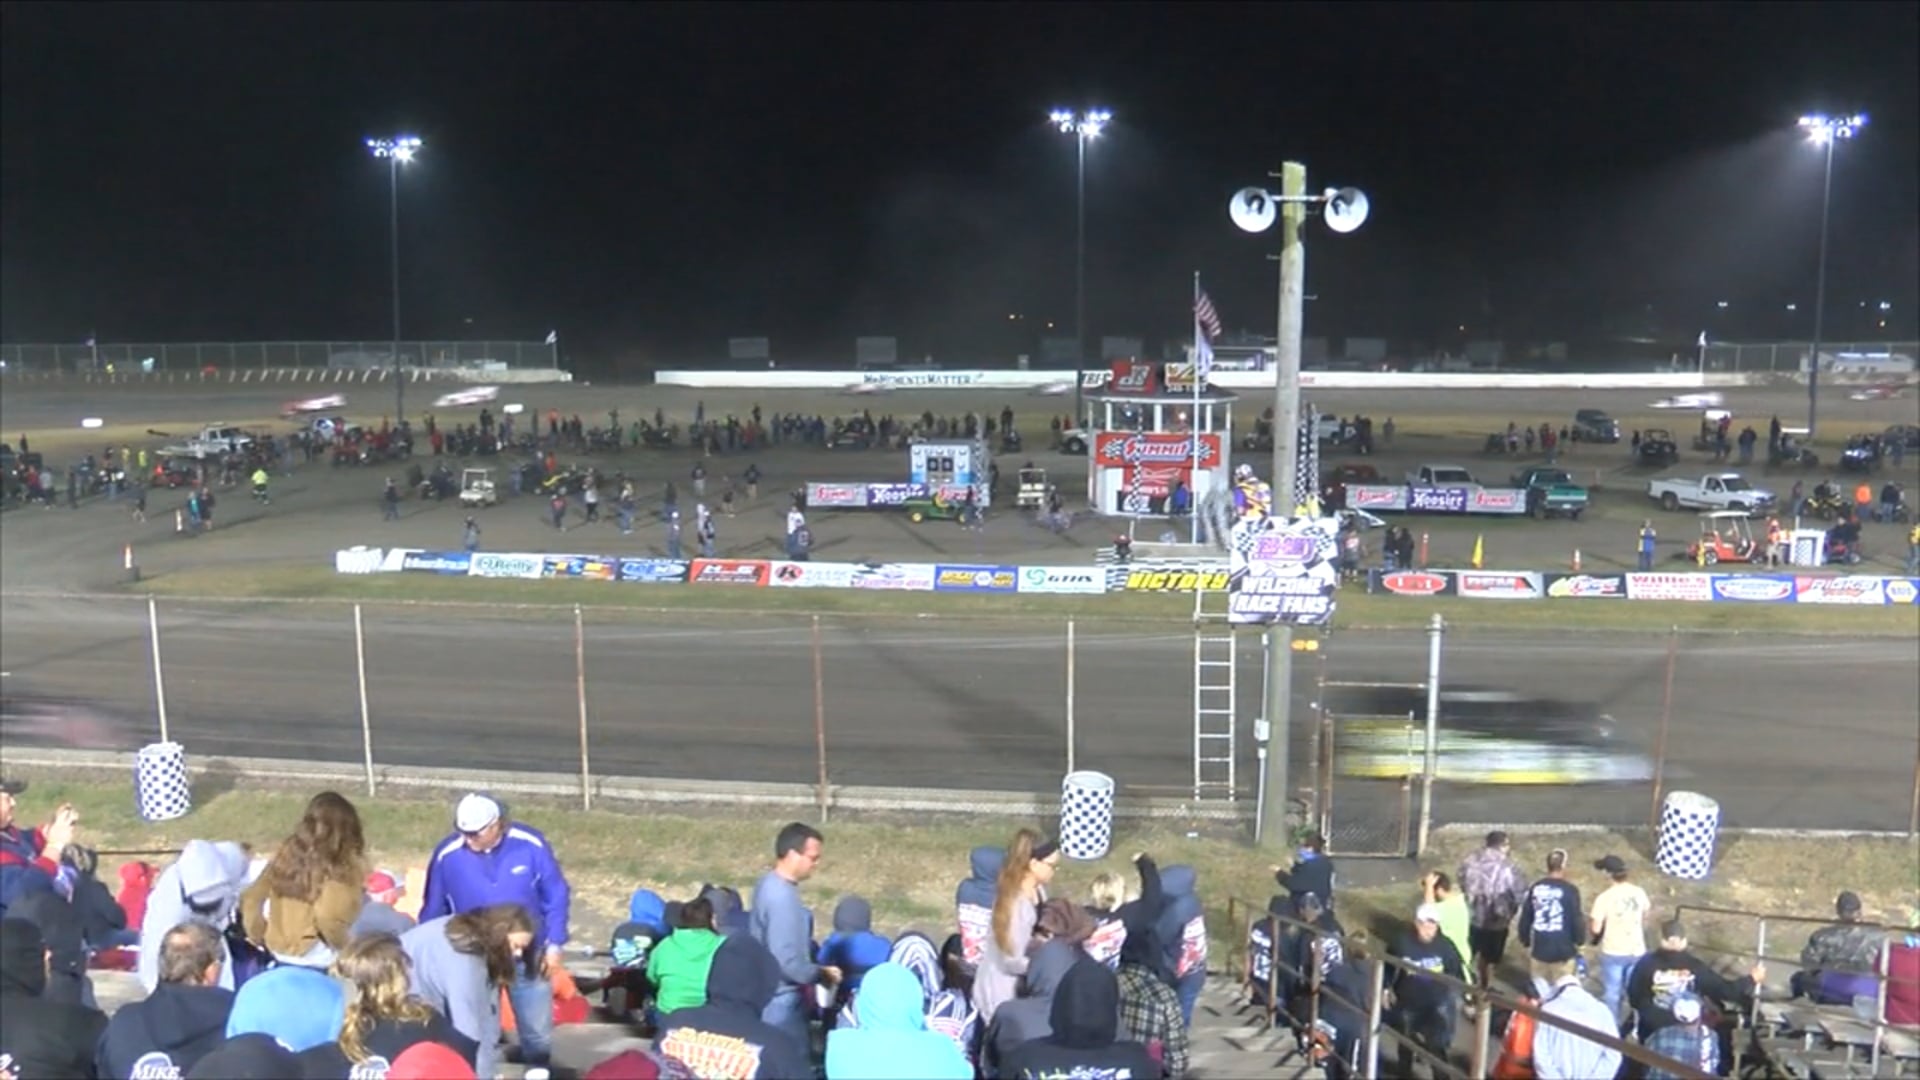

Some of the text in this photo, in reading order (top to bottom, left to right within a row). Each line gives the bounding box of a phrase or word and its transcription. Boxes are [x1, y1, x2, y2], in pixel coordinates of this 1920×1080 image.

[1125, 571, 1231, 590] VICTORY
[1241, 576, 1323, 594] WELCOME
[1235, 595, 1328, 614] RACE FANS
